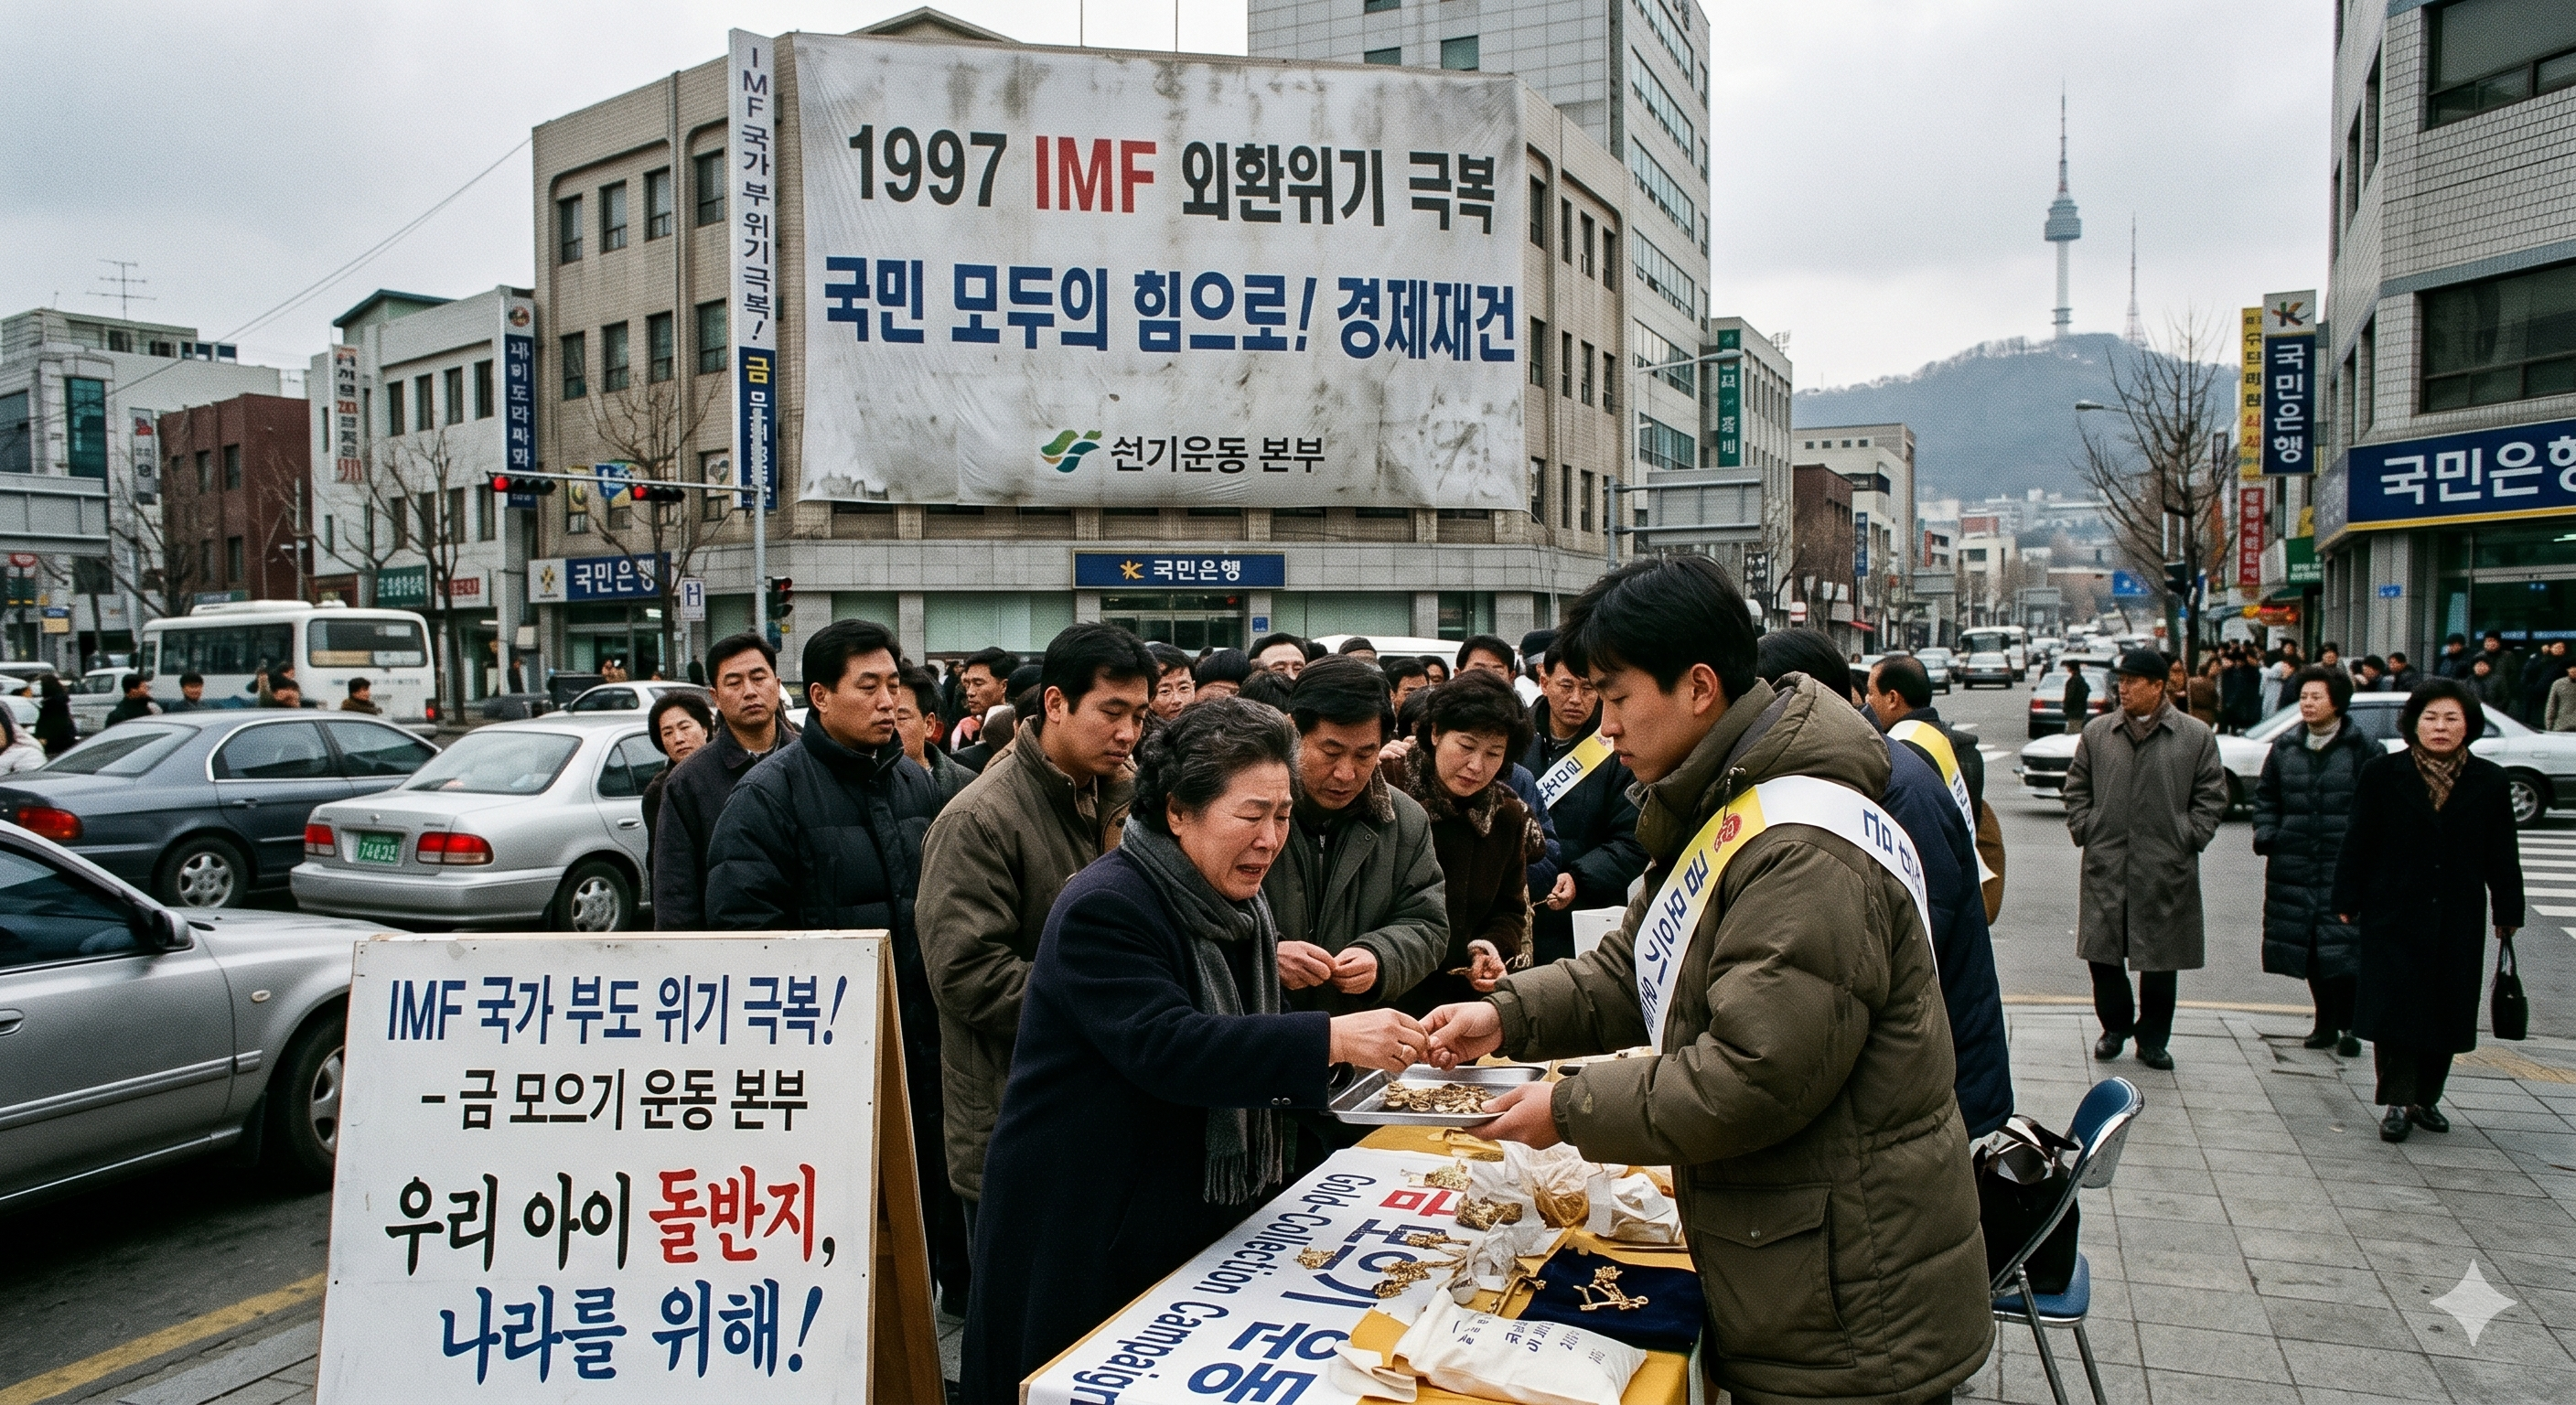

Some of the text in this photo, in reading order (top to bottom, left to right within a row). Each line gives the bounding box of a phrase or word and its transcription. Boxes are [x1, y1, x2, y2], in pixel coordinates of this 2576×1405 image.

[848, 123, 1496, 236] 1997 IMF 외환위기 극복
[824, 255, 1516, 363] 국민 모두의 힘으로! 경제재건
[745, 356, 771, 385] 금
[2274, 342, 2305, 464] 국민은행
[1258, 436, 1326, 474] 본부
[1153, 560, 1241, 582] 국민은행
[387, 974, 849, 1046] IMF 국가 부도 위기 극복!
[458, 1068, 499, 1131] 금
[509, 1067, 626, 1132] 모으기
[639, 1068, 718, 1132] 운동
[730, 1068, 809, 1132] 본부
[384, 1163, 836, 1276] 우리 아이 돌반지,
[439, 1278, 824, 1385] 나라를 위해!
[1069, 1174, 1378, 1405] Gold-Collection Campaign
[1186, 1320, 1352, 1405] 운동
